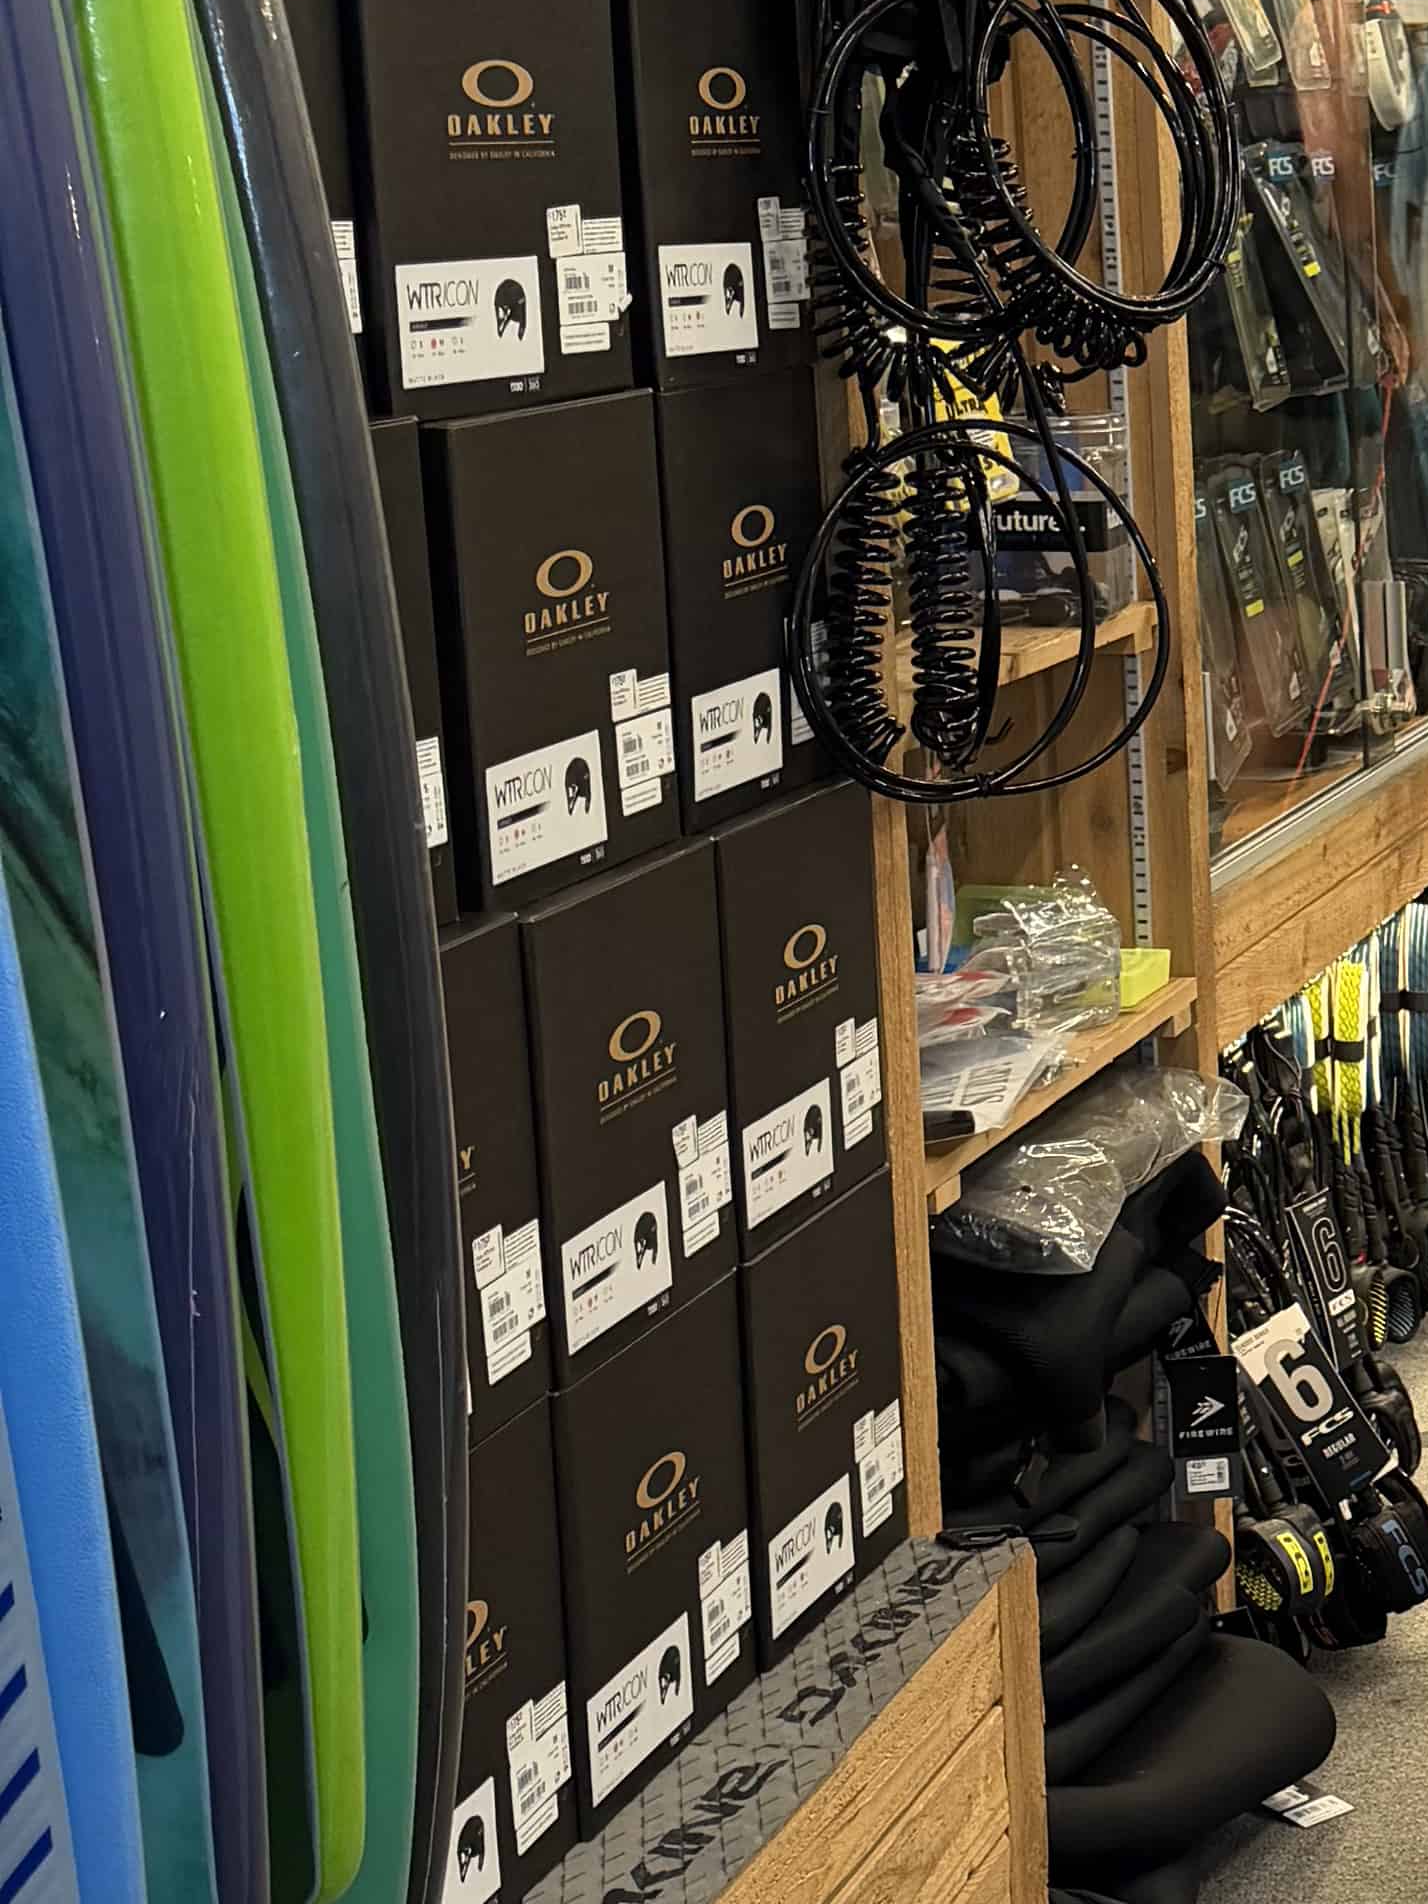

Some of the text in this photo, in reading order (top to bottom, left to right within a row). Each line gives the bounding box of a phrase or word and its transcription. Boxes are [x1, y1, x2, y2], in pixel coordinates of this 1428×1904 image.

[448, 112, 554, 138] OAKLEY
[688, 115, 760, 136] OAKLEY
[1269, 156, 1293, 176] FCS
[1312, 156, 1335, 176] FCS
[1375, 164, 1398, 181] FC
[1229, 482, 1256, 508] FCS
[1279, 465, 1304, 488] FCS
[722, 543, 788, 580] OAKLEY
[524, 592, 610, 635] OAKLEY
[775, 953, 838, 1007] OAKLEY
[598, 1040, 677, 1103] OAKLEY
[1312, 1216, 1348, 1292] 6
[796, 1348, 858, 1408] OAKLEY
[1264, 1338, 1334, 1422] 6
[1178, 1426, 1234, 1440] FIREWIRE
[1301, 1406, 1354, 1446] FCS
[625, 1475, 700, 1555] OAKLEY
